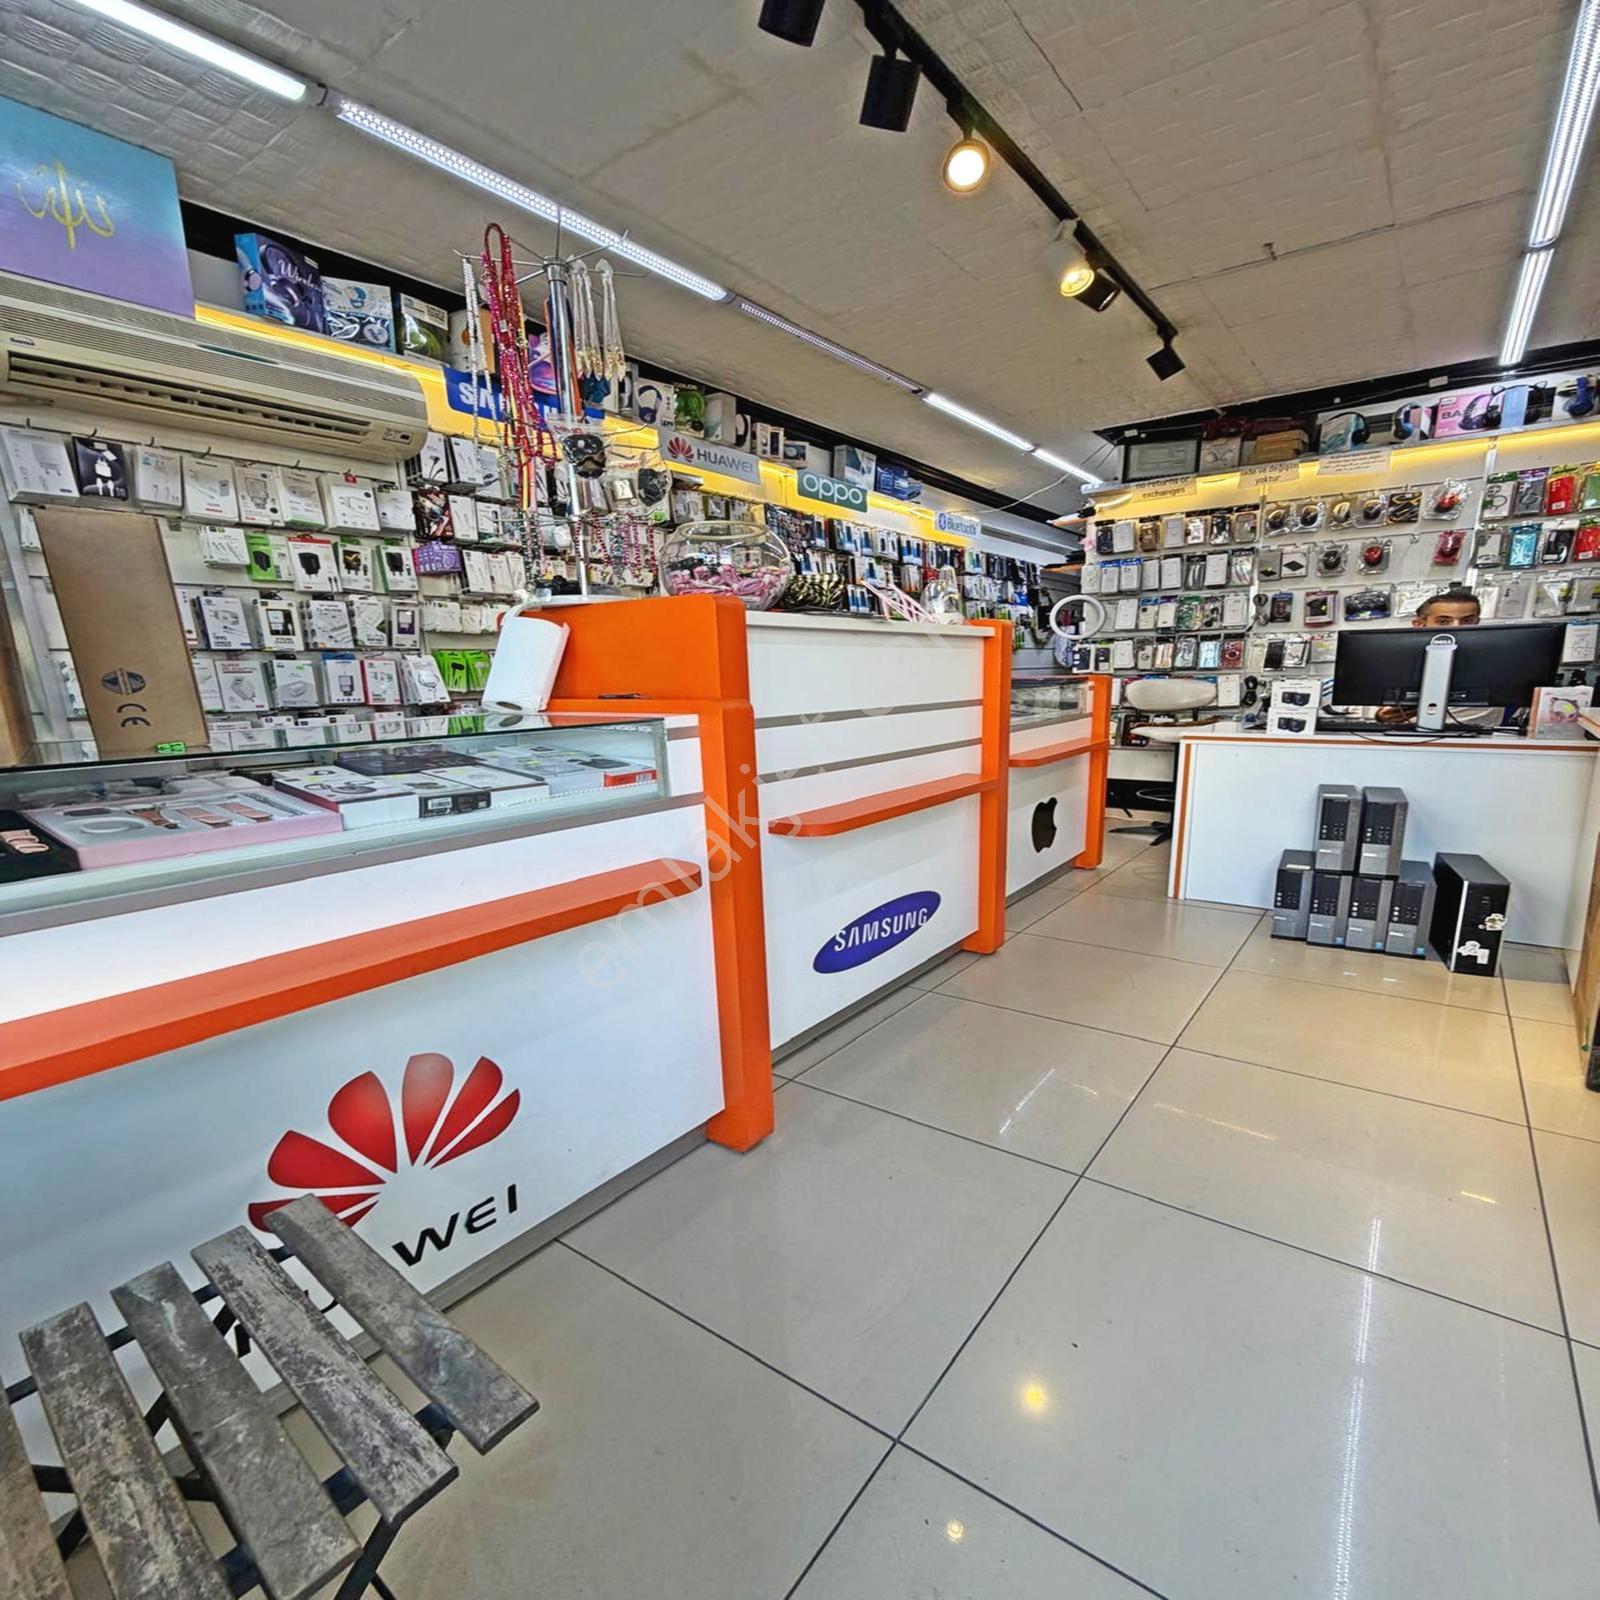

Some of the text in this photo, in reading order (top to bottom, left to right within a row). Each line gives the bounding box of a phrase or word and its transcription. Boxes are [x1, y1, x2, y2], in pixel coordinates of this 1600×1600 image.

[697, 448, 753, 472] HUAWEI
[803, 474, 863, 504] oppo
[1147, 477, 1179, 488] returns
[1180, 476, 1190, 484] or
[1255, 475, 1281, 485] yoktur
[1142, 487, 1185, 498] exchanges
[947, 517, 976, 535] Bluetooth
[833, 907, 929, 952] SAMSUNG
